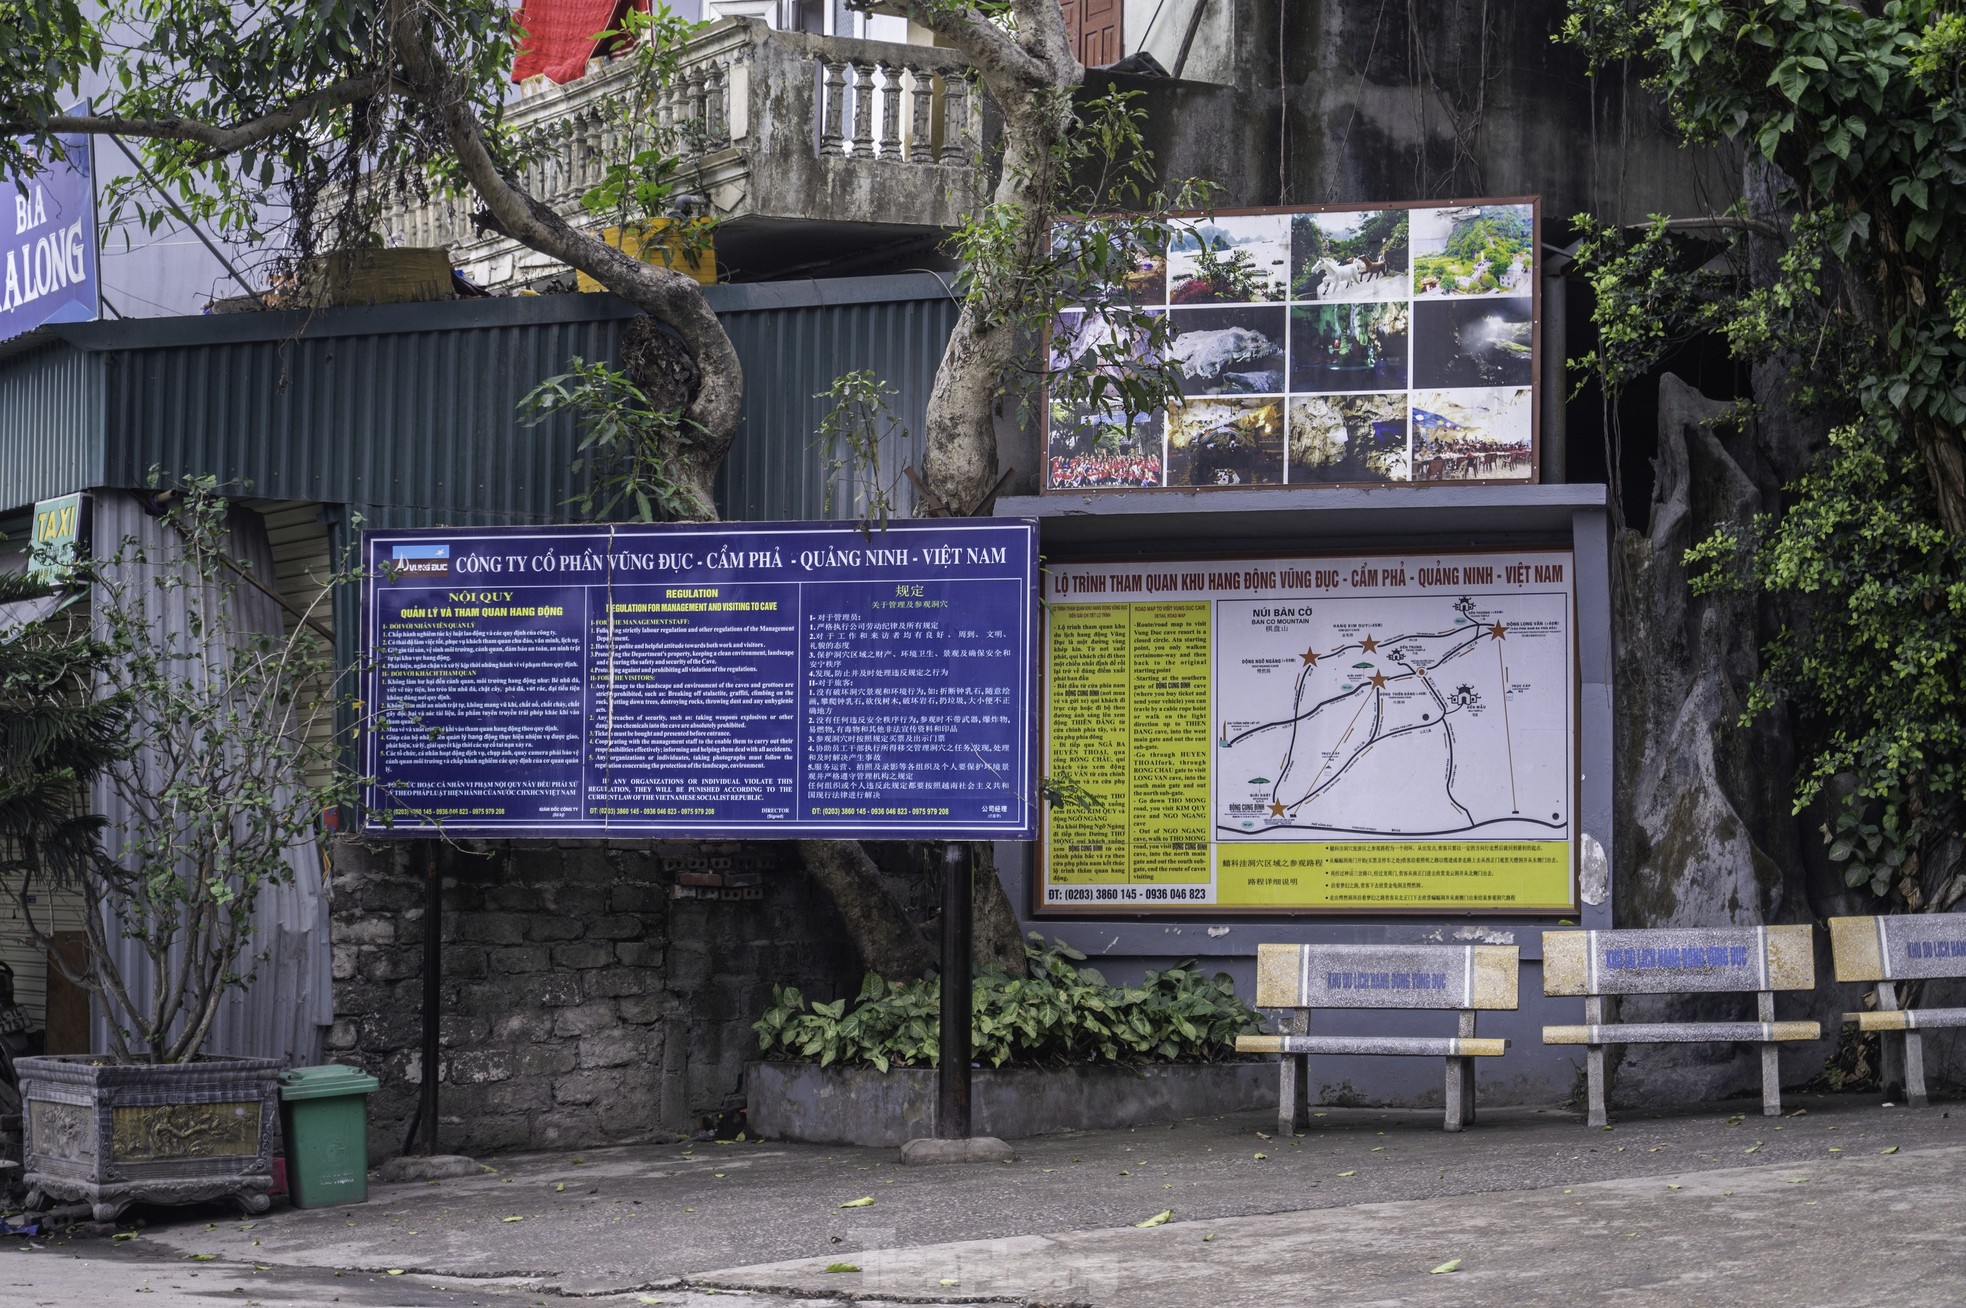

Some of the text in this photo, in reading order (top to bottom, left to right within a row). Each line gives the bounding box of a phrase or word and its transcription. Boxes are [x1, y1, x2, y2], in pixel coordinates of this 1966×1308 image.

[15, 185, 48, 235] BIA
[0, 216, 87, 314] ALONG
[38, 505, 76, 542] TAXI
[455, 552, 501, 573] CÔNG
[505, 556, 527, 571] TY
[532, 548, 555, 571] CỔ
[559, 547, 602, 571] PHẦN
[658, 553, 692, 573] ĐỤC
[706, 544, 743, 568] CẨM
[748, 546, 782, 567] PHẢ
[800, 545, 861, 570] QUẢNG
[865, 549, 908, 565] NINH
[922, 543, 962, 568] VIỆT
[966, 547, 1006, 564] NAM
[1055, 572, 1068, 597] LỘ
[1071, 571, 1106, 592] TRÌNH
[1109, 574, 1142, 592] THAM
[1146, 573, 1177, 593] QUAN
[1181, 572, 1204, 590] KHU
[1208, 571, 1240, 590] HANG
[1243, 567, 1275, 593] ĐỘNG
[1279, 567, 1311, 588] VŨNG
[1315, 570, 1338, 591] ĐỤC
[1351, 563, 1377, 587] CẨM
[1382, 562, 1406, 586] PHẢ
[1418, 561, 1459, 587] QUẢNG
[1463, 566, 1492, 584] NINH
[1505, 561, 1531, 587] VIỆT
[1534, 564, 1562, 582] NAM
[666, 588, 719, 598] REGULATION
[896, 584, 923, 597] 规定
[449, 590, 513, 603] NỘI QUY
[648, 602, 661, 612] FOR
[661, 602, 708, 612] MANAGEMENT
[708, 601, 722, 612] AND
[722, 601, 750, 611] VISITING
[751, 601, 760, 611] TO
[760, 601, 777, 611] CAVE
[872, 599, 949, 609] 关于管理及参观洞穴
[400, 605, 562, 618] QUẢN LÝ VÀ THAM QUAN HANG ĐỘNG
[1253, 606, 1313, 617] NÚI BÀN CỜ
[1266, 617, 1276, 625] CO
[1277, 617, 1310, 625] MOUNTAIN
[1265, 624, 1289, 633] 棋盘山
[1165, 658, 1176, 666] the
[1180, 658, 1207, 667] original
[614, 777, 627, 785] ANY
[630, 777, 684, 785] ORGANIZATIONS
[701, 777, 741, 785] INDIVIDUAL
[744, 777, 773, 785] VIOLATE
[777, 777, 793, 785] THIS
[634, 785, 652, 793] THEY
[655, 785, 673, 793] WILL
[676, 785, 685, 793] BE
[688, 785, 720, 793] PUNISHED
[723, 785, 763, 793] ACCORDING
[766, 785, 776, 793] TO
[779, 785, 793, 793] THE
[618, 793, 632, 801] LAW
[642, 793, 655, 801] THE
[655, 793, 696, 801] VIETNAMESE
[730, 793, 764, 801] REPUBLIC.
[811, 806, 822, 815] ĐT:
[822, 806, 841, 816] (0203)
[841, 806, 855, 815] 3860
[856, 806, 867, 815] 145
[870, 806, 885, 815] 0936
[885, 807, 897, 815] 046
[897, 806, 908, 815] 823
[912, 807, 926, 815] 0975
[926, 807, 938, 816] 979
[938, 807, 949, 815] 208
[981, 804, 1008, 813] 公司经理
[1247, 877, 1298, 886] 路程详细说明
[1048, 889, 1062, 899] ĐT:
[1065, 889, 1094, 900] (0203)
[1096, 889, 1118, 899] 3860
[1120, 888, 1137, 899] 145
[1145, 888, 1168, 899] 0936
[1170, 888, 1187, 899] 046
[1189, 888, 1206, 899] 823
